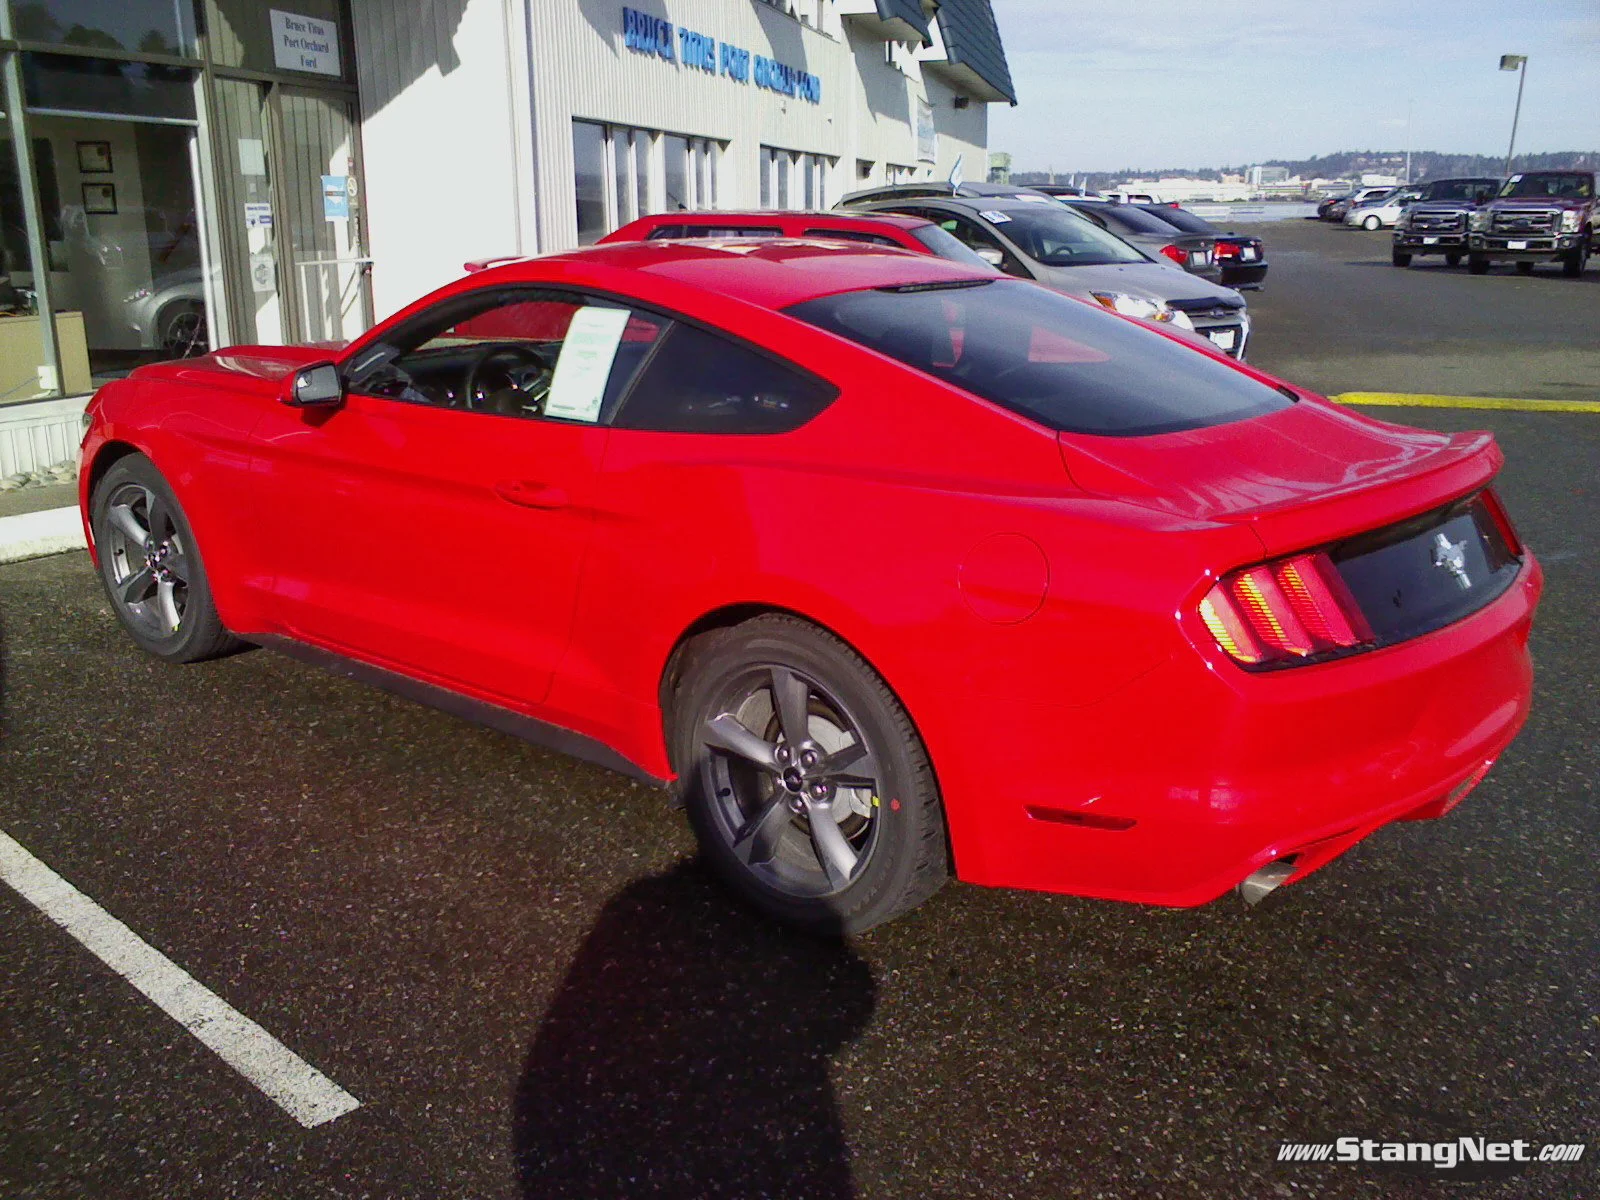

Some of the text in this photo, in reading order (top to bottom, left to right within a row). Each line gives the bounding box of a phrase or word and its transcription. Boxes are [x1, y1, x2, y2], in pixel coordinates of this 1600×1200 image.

[285, 16, 306, 33] Bruce
[283, 34, 329, 54] Port Orchard
[300, 54, 317, 69] Ford
